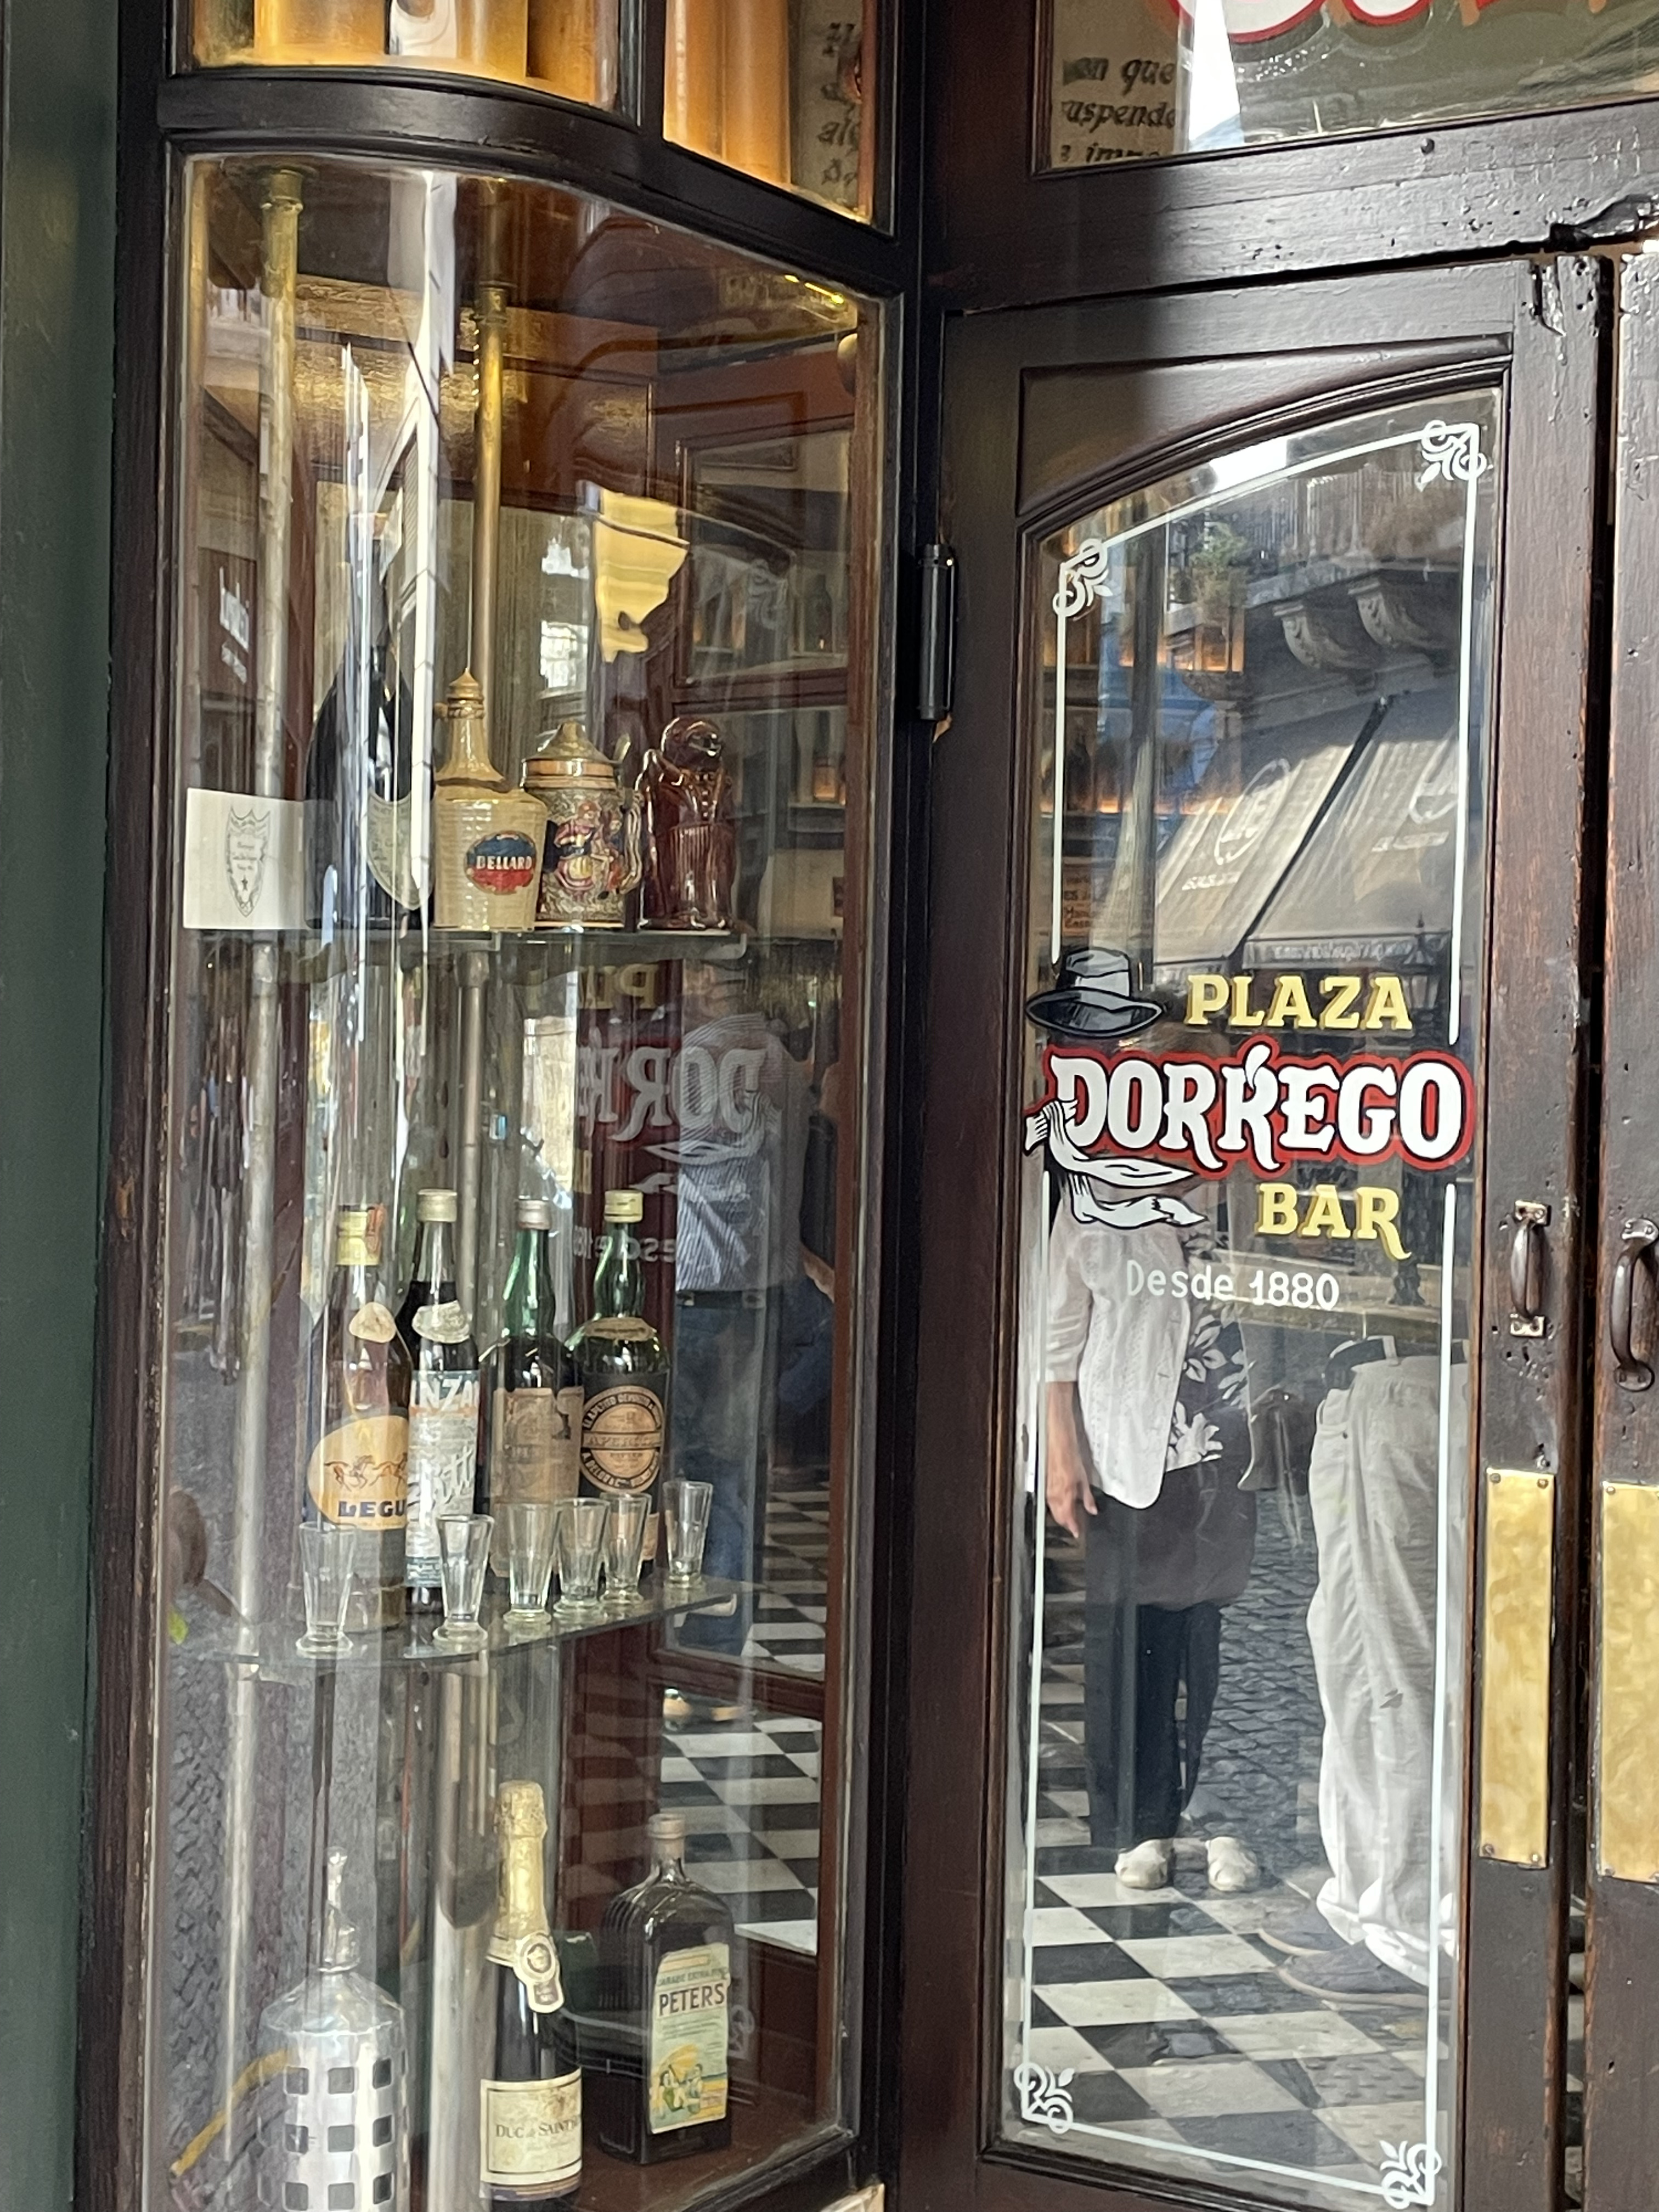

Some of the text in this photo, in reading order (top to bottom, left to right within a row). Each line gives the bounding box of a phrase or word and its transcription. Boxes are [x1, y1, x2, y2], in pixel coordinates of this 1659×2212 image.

[1122, 58, 1176, 95] que
[1184, 974, 1412, 1031] PLAZA
[1048, 1042, 1466, 1172] DORREGO
[1255, 1183, 1412, 1260] BAR
[1126, 1259, 1340, 1311] Desde 1880
[659, 1983, 725, 2017] PETERS
[496, 2124, 524, 2138] DUC
